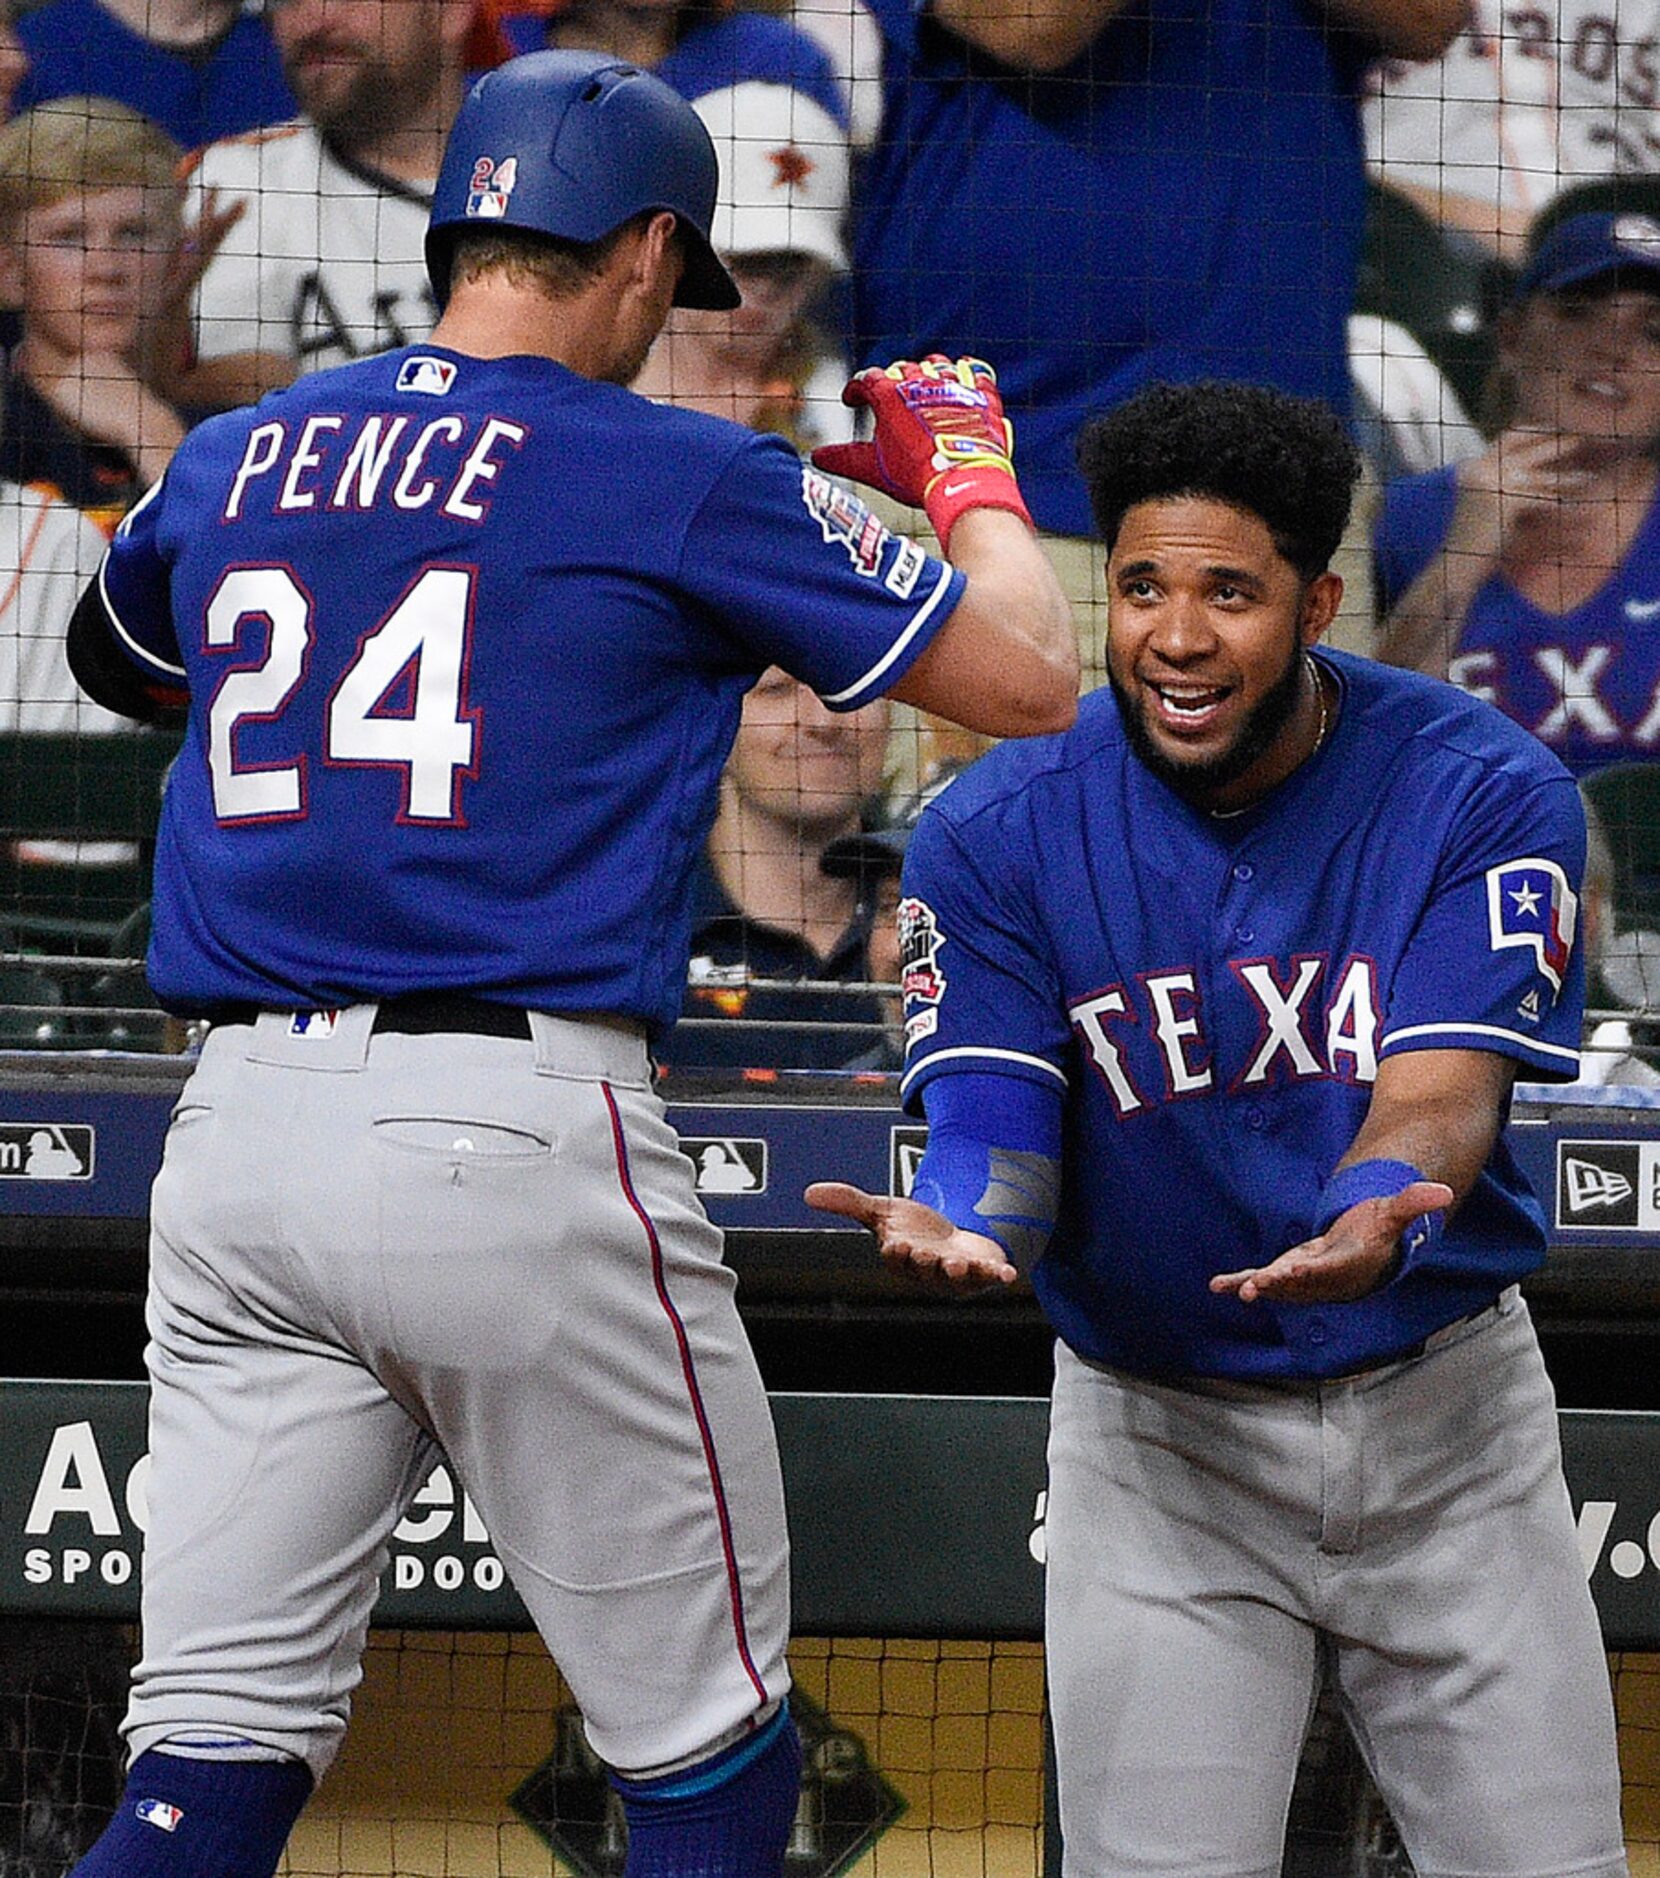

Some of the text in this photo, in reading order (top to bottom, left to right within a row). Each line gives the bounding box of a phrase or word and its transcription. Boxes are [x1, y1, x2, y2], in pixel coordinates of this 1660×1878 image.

[470, 156, 517, 193] 24
[223, 414, 528, 524] PENCE
[202, 562, 482, 827] 24
[1068, 953, 1381, 1118] TEXA
